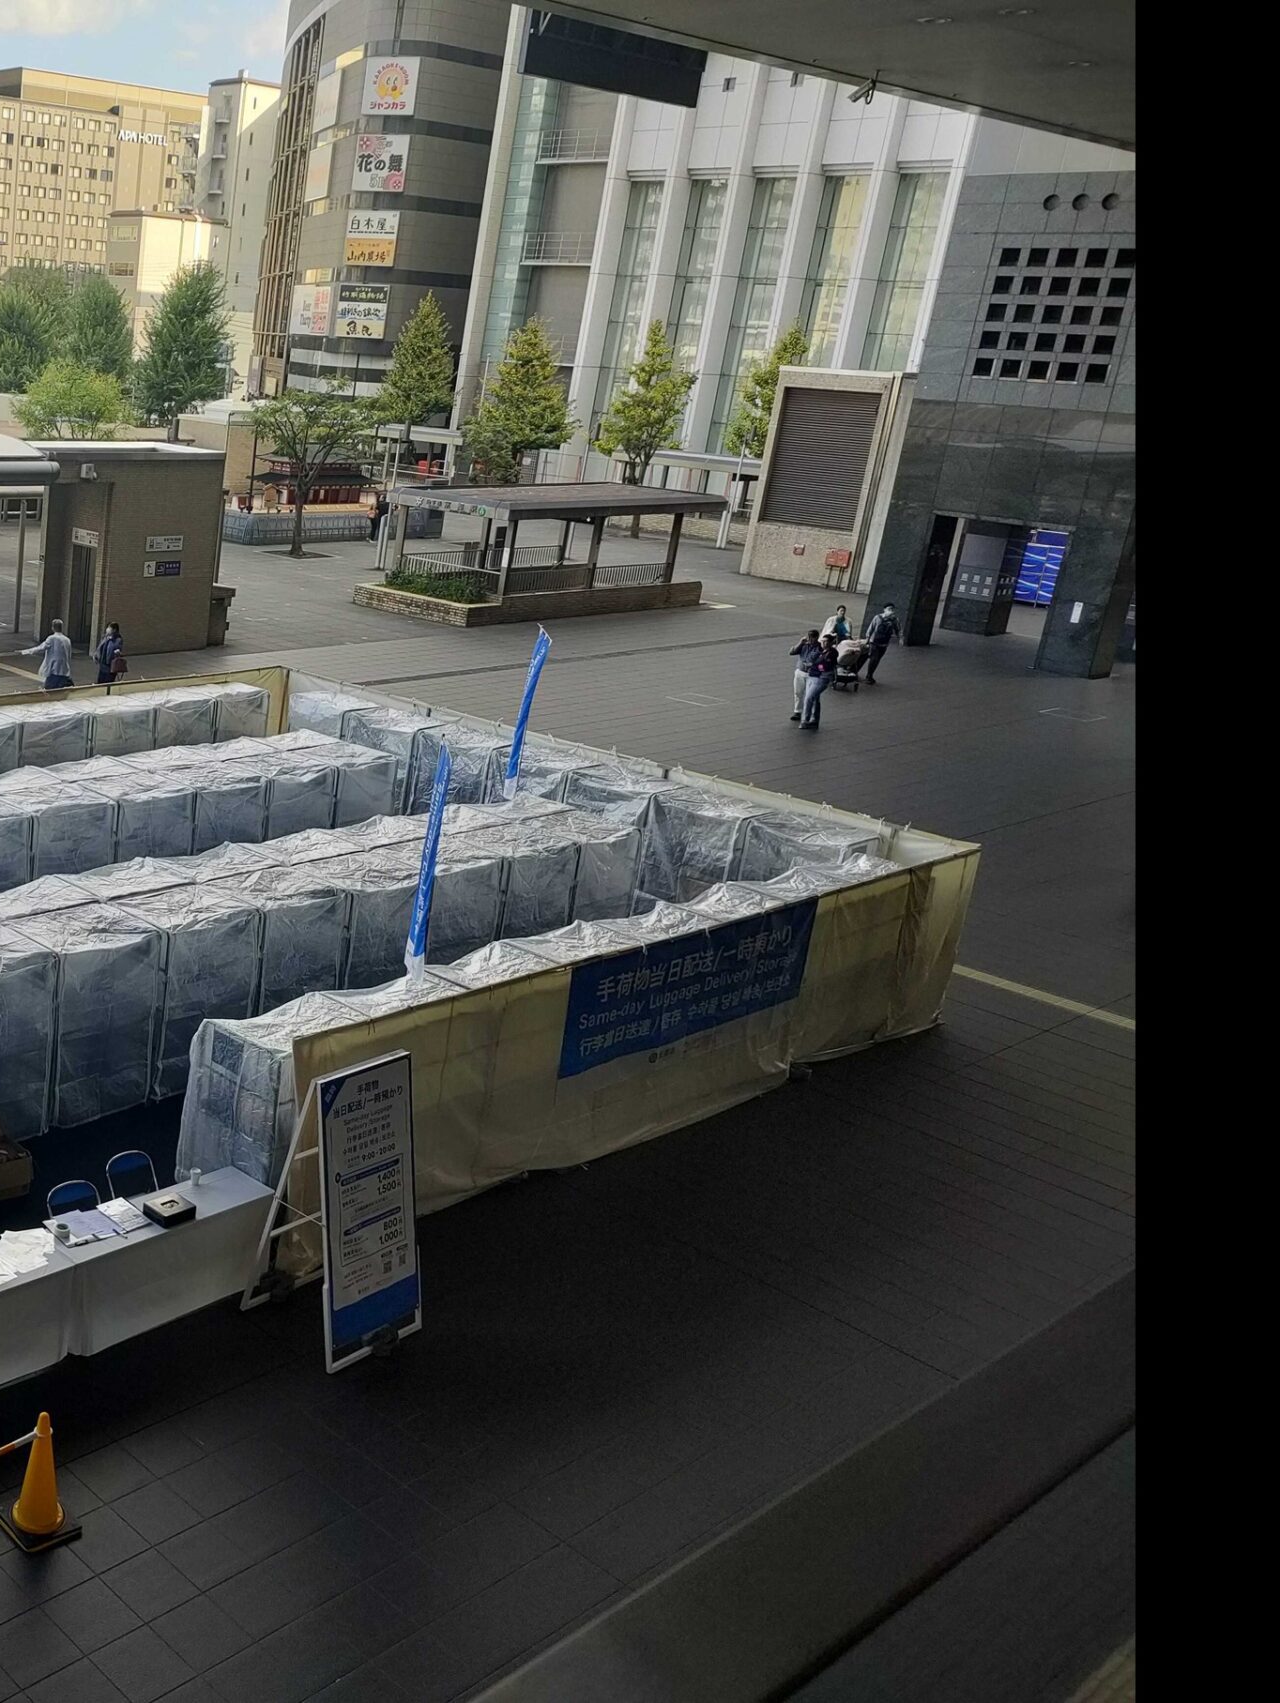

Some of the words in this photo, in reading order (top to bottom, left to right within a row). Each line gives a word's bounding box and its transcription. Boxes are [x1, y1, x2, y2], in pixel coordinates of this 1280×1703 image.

[369, 101, 406, 110] ジャンカラ
[118, 129, 137, 142] APA
[138, 132, 168, 146] HOTEL
[357, 153, 403, 173] 花の舞
[350, 215, 387, 231] 白木屋
[346, 321, 373, 337] 魚民
[579, 1002, 644, 1030] Same-day
[650, 982, 701, 1009] Luggage
[356, 1079, 379, 1096] 手荷物
